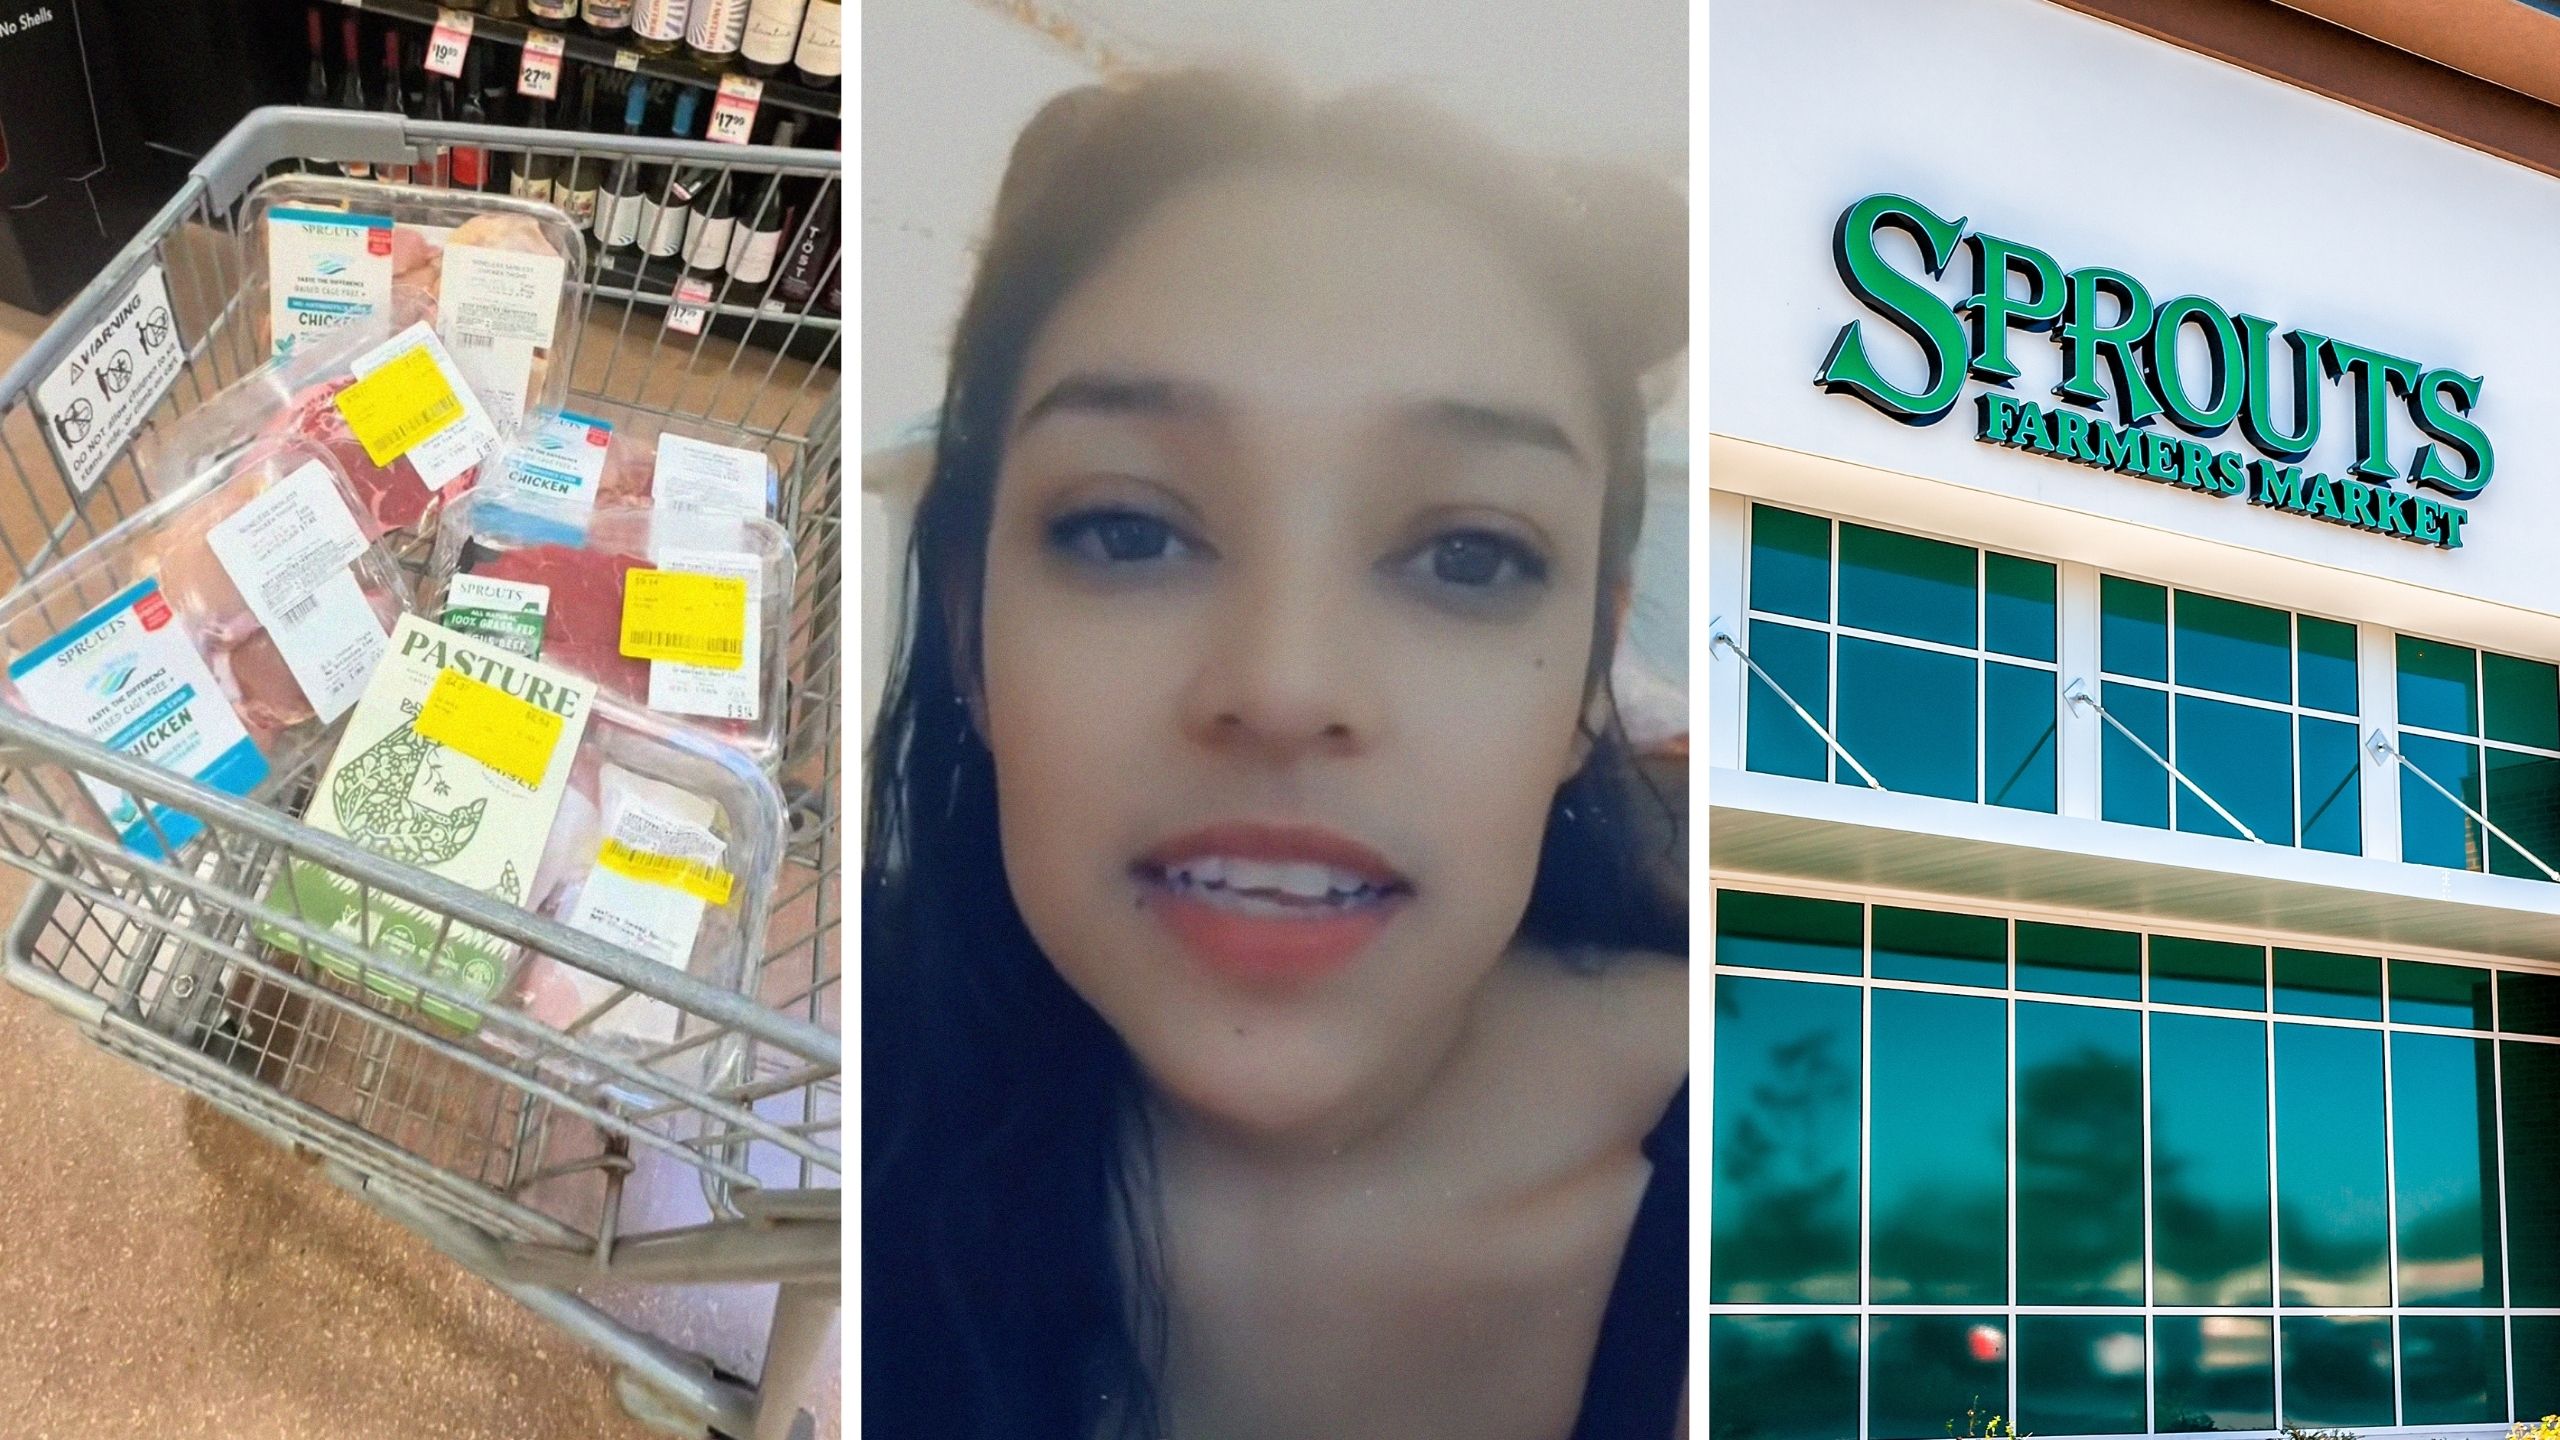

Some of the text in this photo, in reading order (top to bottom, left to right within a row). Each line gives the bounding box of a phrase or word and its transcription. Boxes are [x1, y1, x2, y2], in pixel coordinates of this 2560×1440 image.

[0, 6, 54, 38] No Shells
[301, 224, 360, 238] SPROUTS
[1813, 192, 2496, 500] SPROUTS
[87, 428, 107, 453] NOT
[508, 470, 570, 495] CHICKEN
[1975, 391, 2469, 550] FARMERS MARKET
[459, 583, 524, 601] SPROUTS
[451, 613, 477, 626] 100%
[516, 624, 537, 636] FED
[56, 618, 127, 668] SPROUTS
[401, 630, 582, 720] PASTURE
[128, 707, 194, 759] HICKEN
